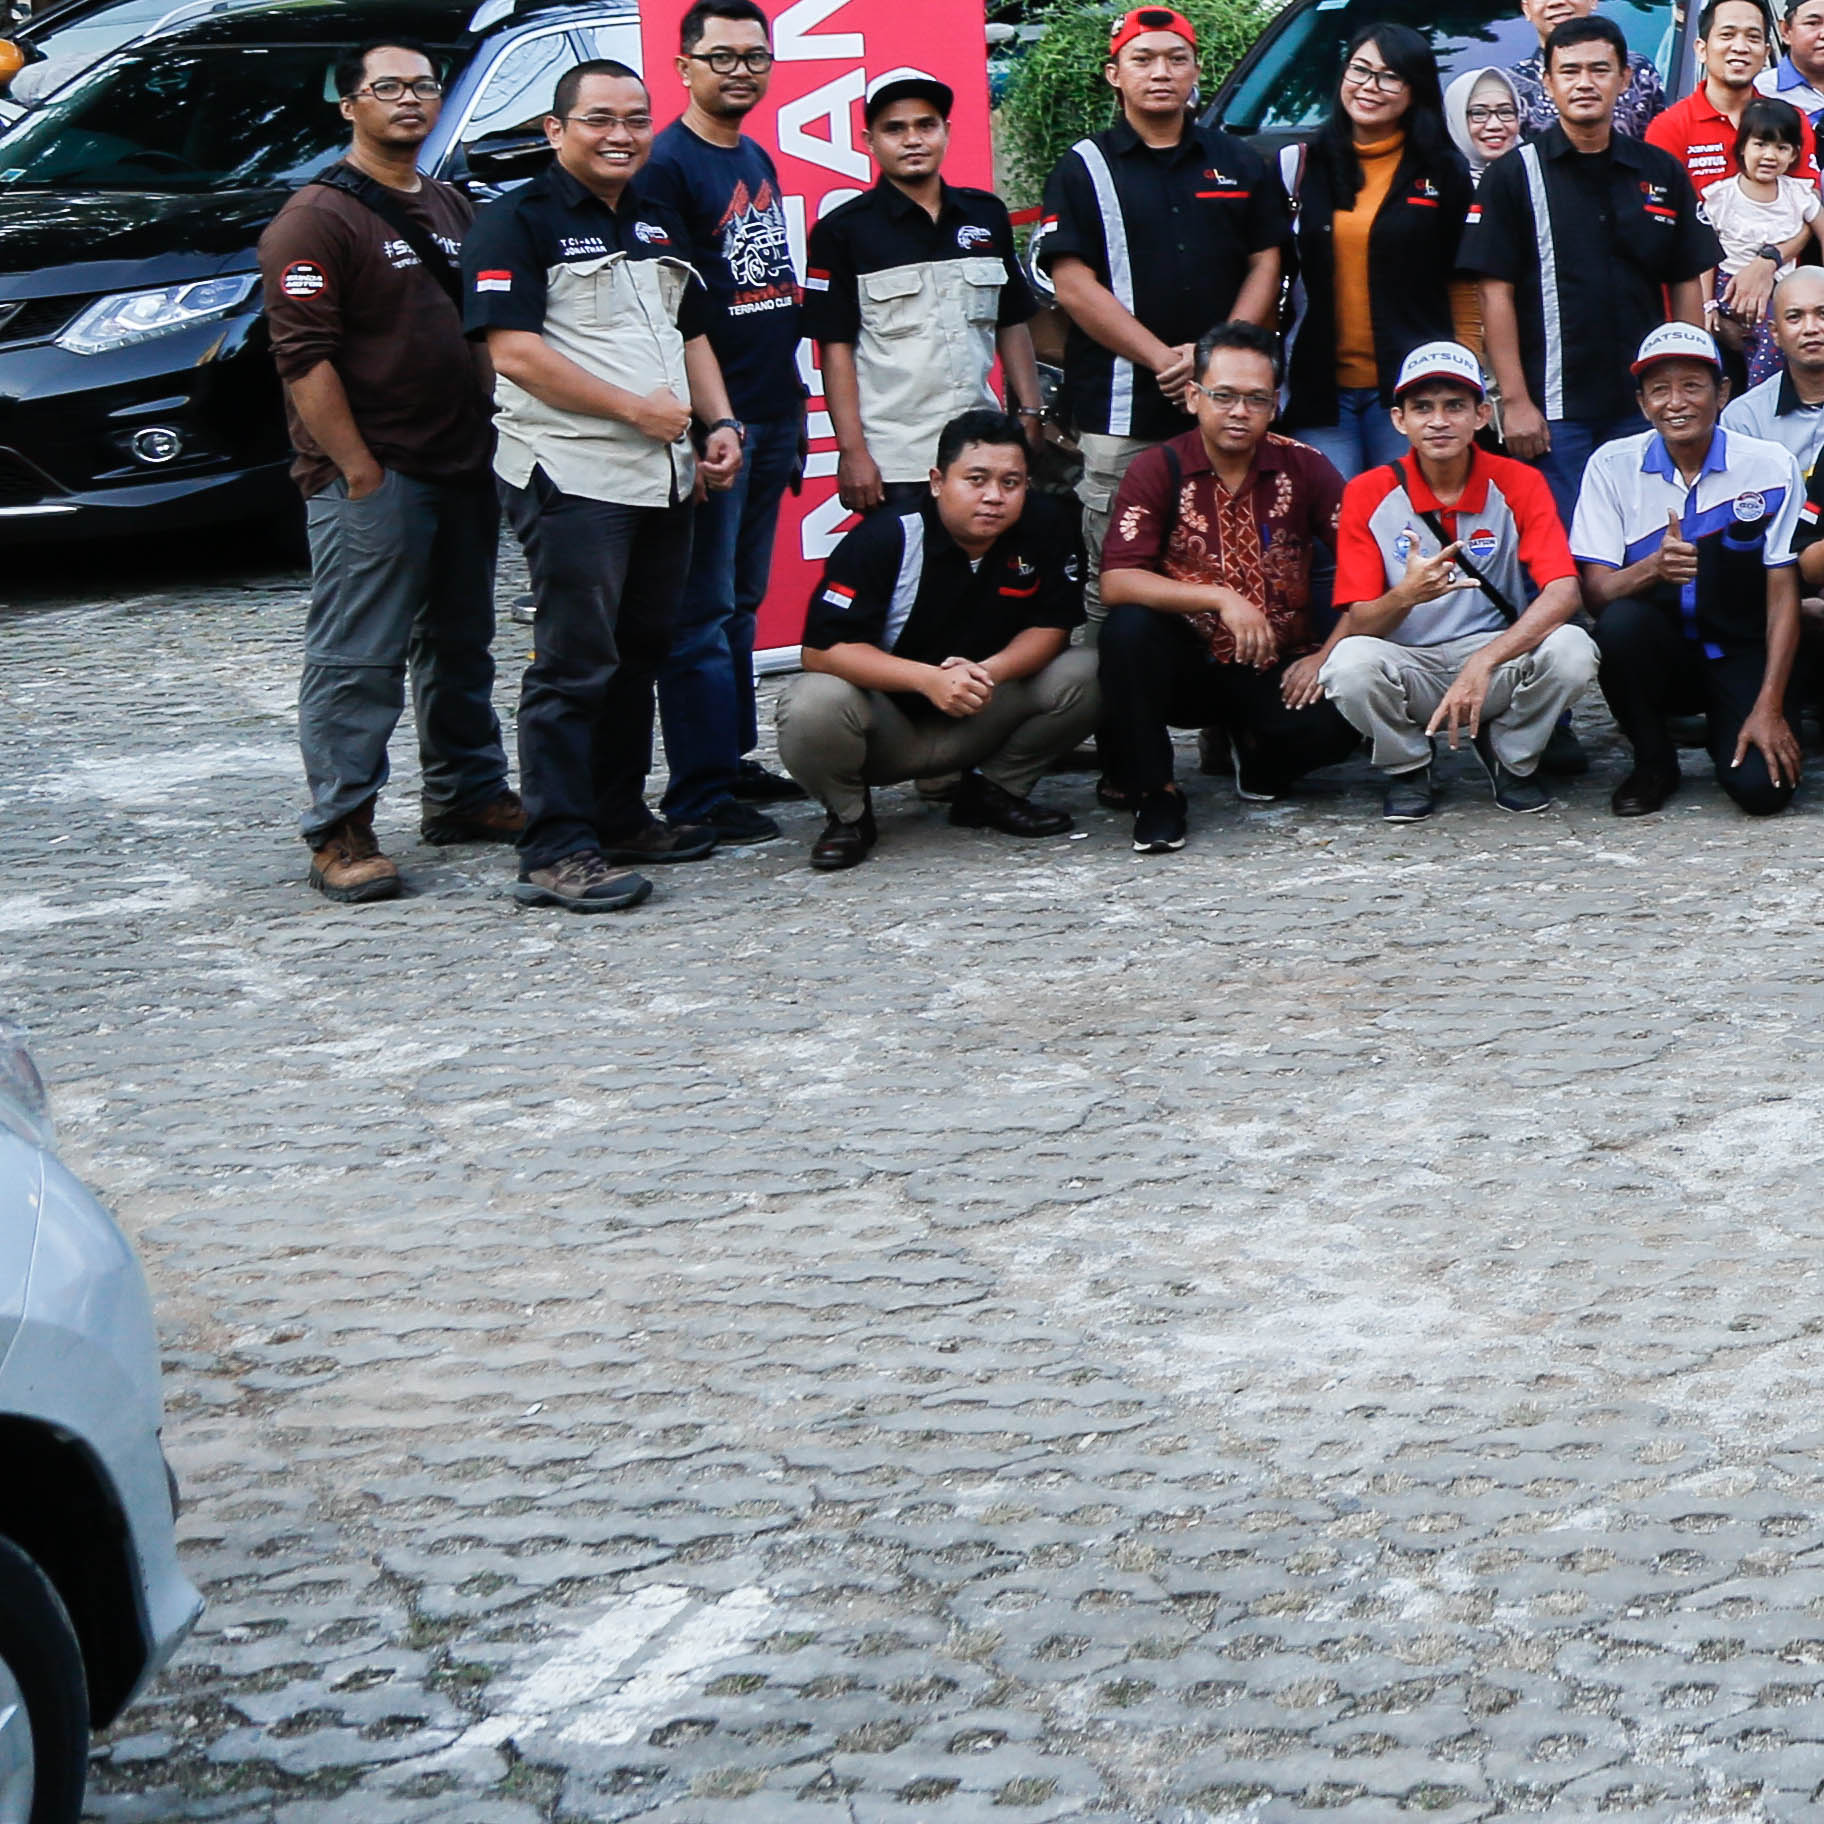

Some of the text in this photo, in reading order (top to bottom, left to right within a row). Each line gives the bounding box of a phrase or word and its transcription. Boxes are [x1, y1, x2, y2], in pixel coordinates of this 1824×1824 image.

[1688, 155, 1728, 169] MOTUL
[728, 299, 774, 316] TERRANO
[1644, 331, 1707, 353] DATSUN
[1407, 352, 1474, 370] DATSUN
